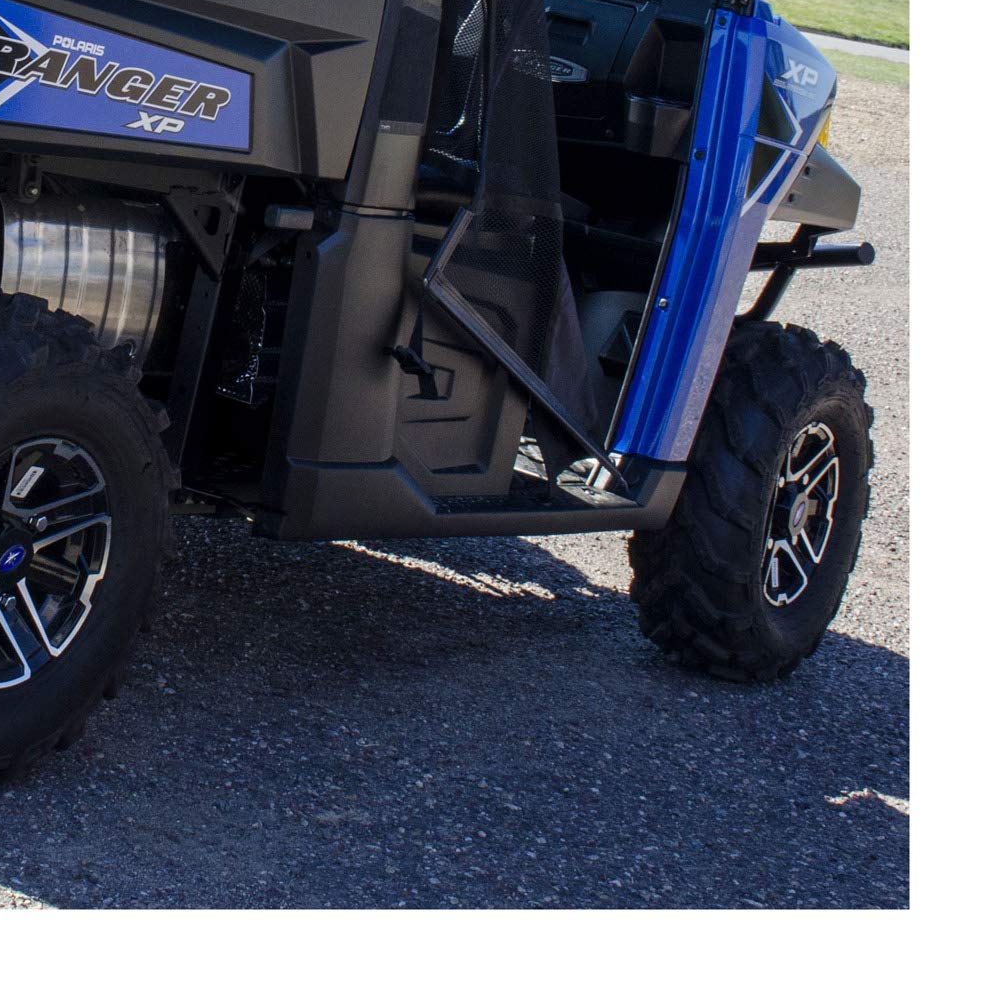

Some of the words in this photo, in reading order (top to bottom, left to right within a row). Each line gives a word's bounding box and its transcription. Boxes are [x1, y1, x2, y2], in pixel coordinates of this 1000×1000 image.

[52, 34, 105, 56] POLARIS
[780, 58, 818, 86] XP
[123, 110, 185, 134] XP
